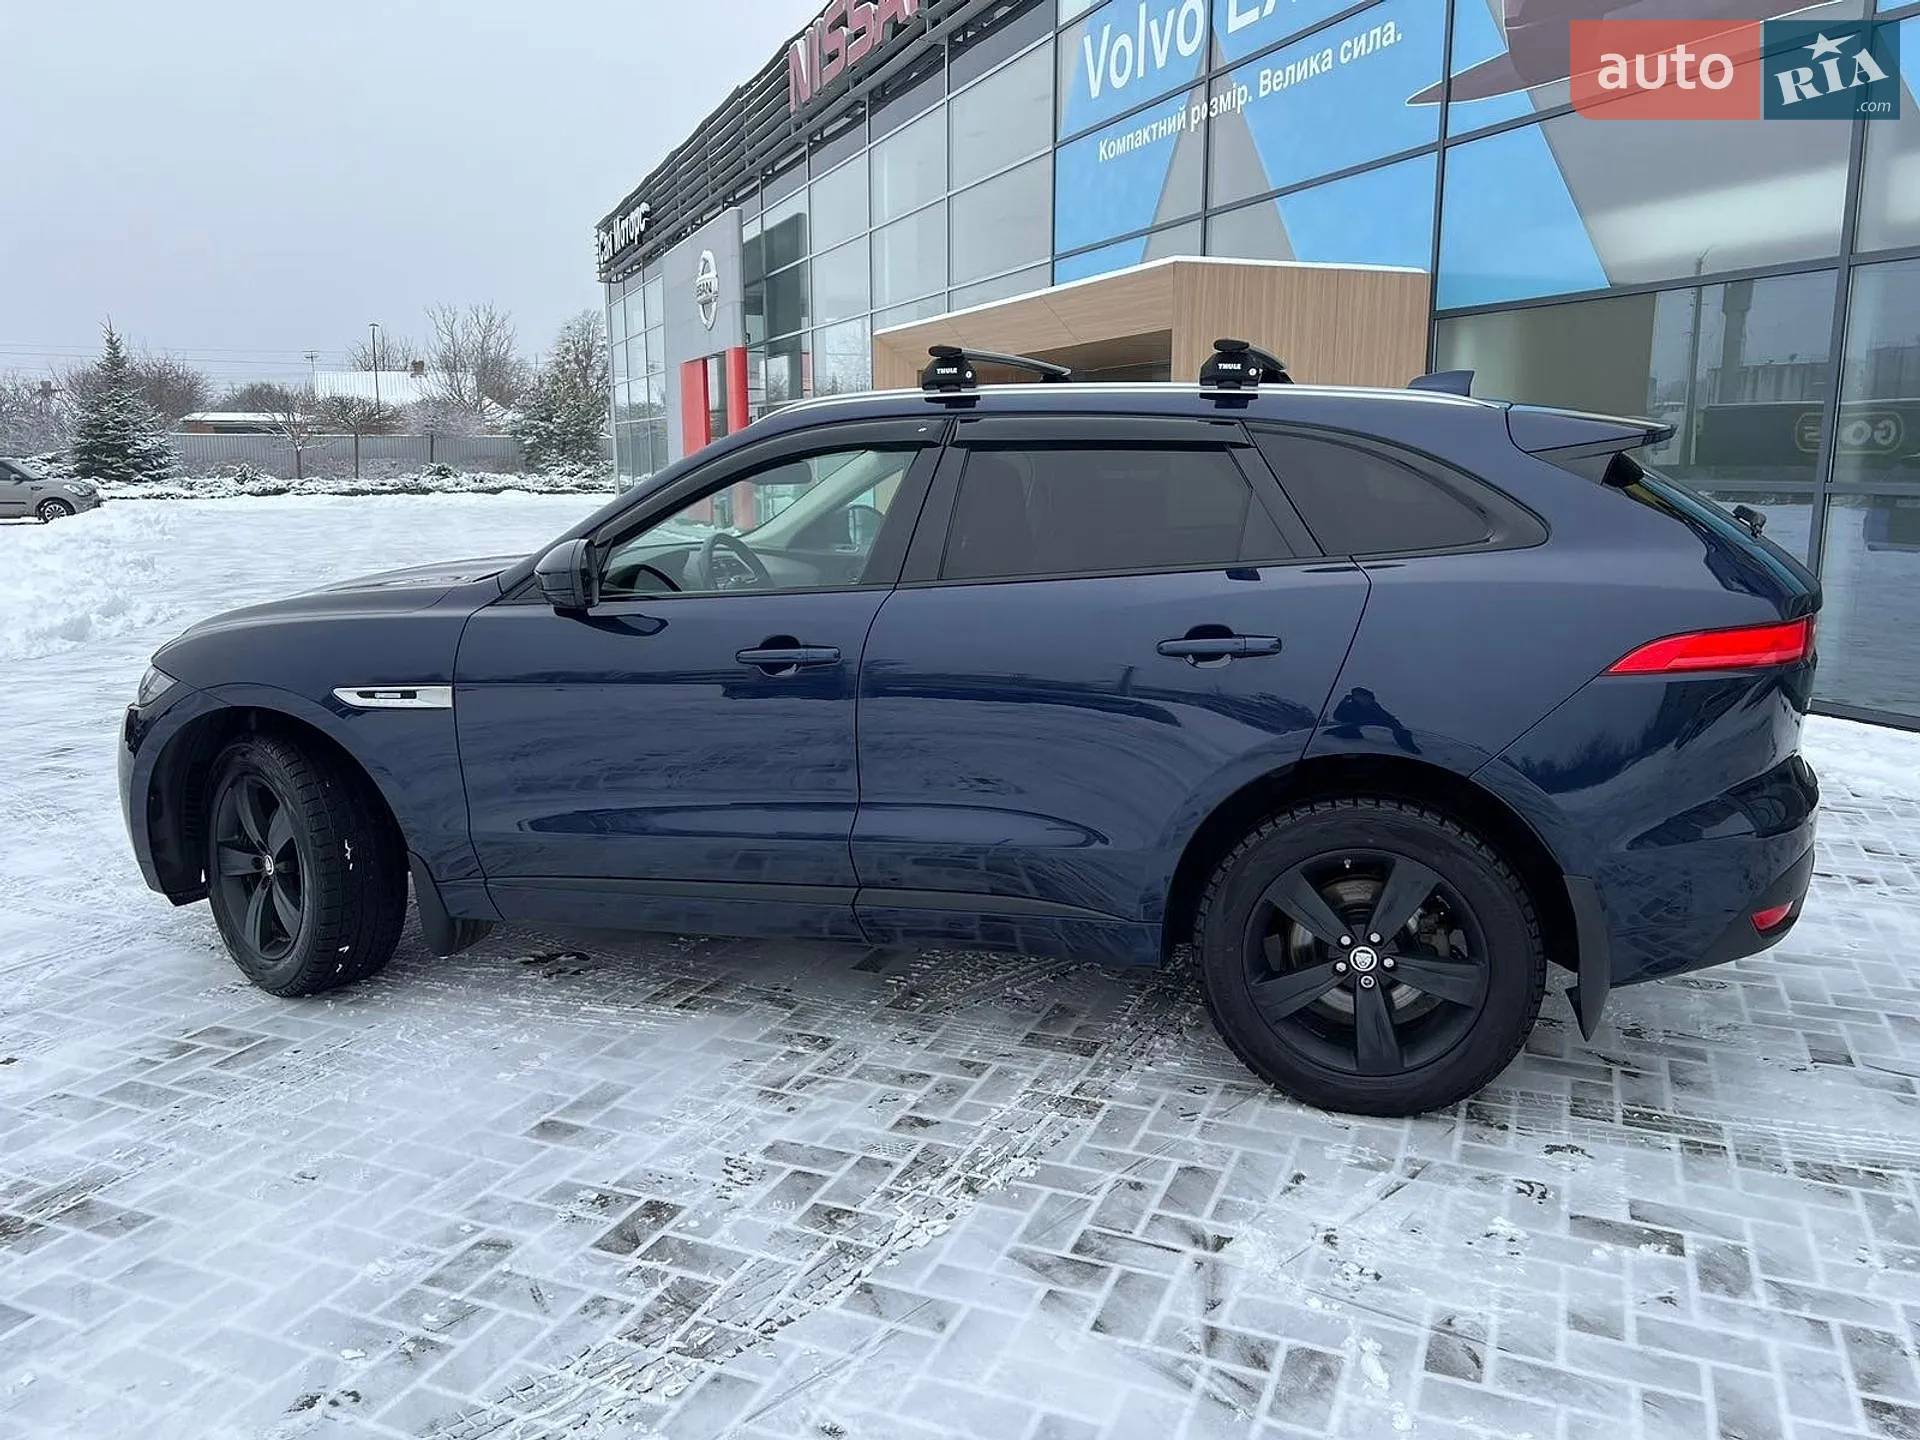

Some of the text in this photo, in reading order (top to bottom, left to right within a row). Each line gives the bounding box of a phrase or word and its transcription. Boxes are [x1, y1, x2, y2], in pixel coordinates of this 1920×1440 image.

[1083, 0, 1205, 99] Volvo
[1099, 20, 1402, 161] Компактний розмір. Велика сила.
[936, 367, 958, 375] THULE
